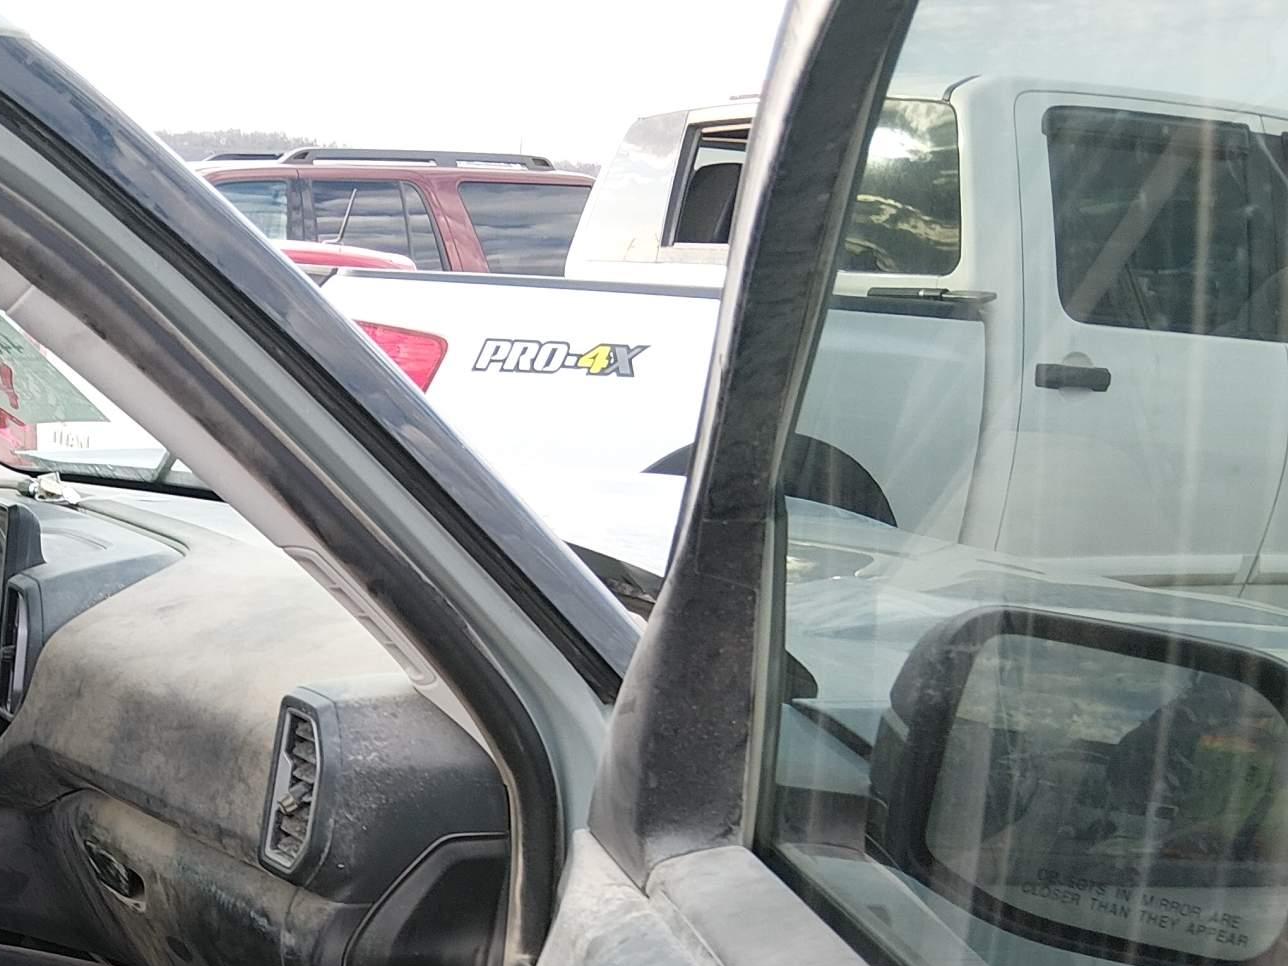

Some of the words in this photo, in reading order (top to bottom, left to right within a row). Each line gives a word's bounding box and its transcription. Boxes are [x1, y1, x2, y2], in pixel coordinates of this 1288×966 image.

[471, 337, 651, 378] PRO-4X
[1021, 882, 1081, 906] CLOSER
[1090, 896, 1130, 919] THAN
[1139, 909, 1181, 930] THEY
[1185, 922, 1249, 948] APPEAR
[1210, 911, 1242, 930] ARE
